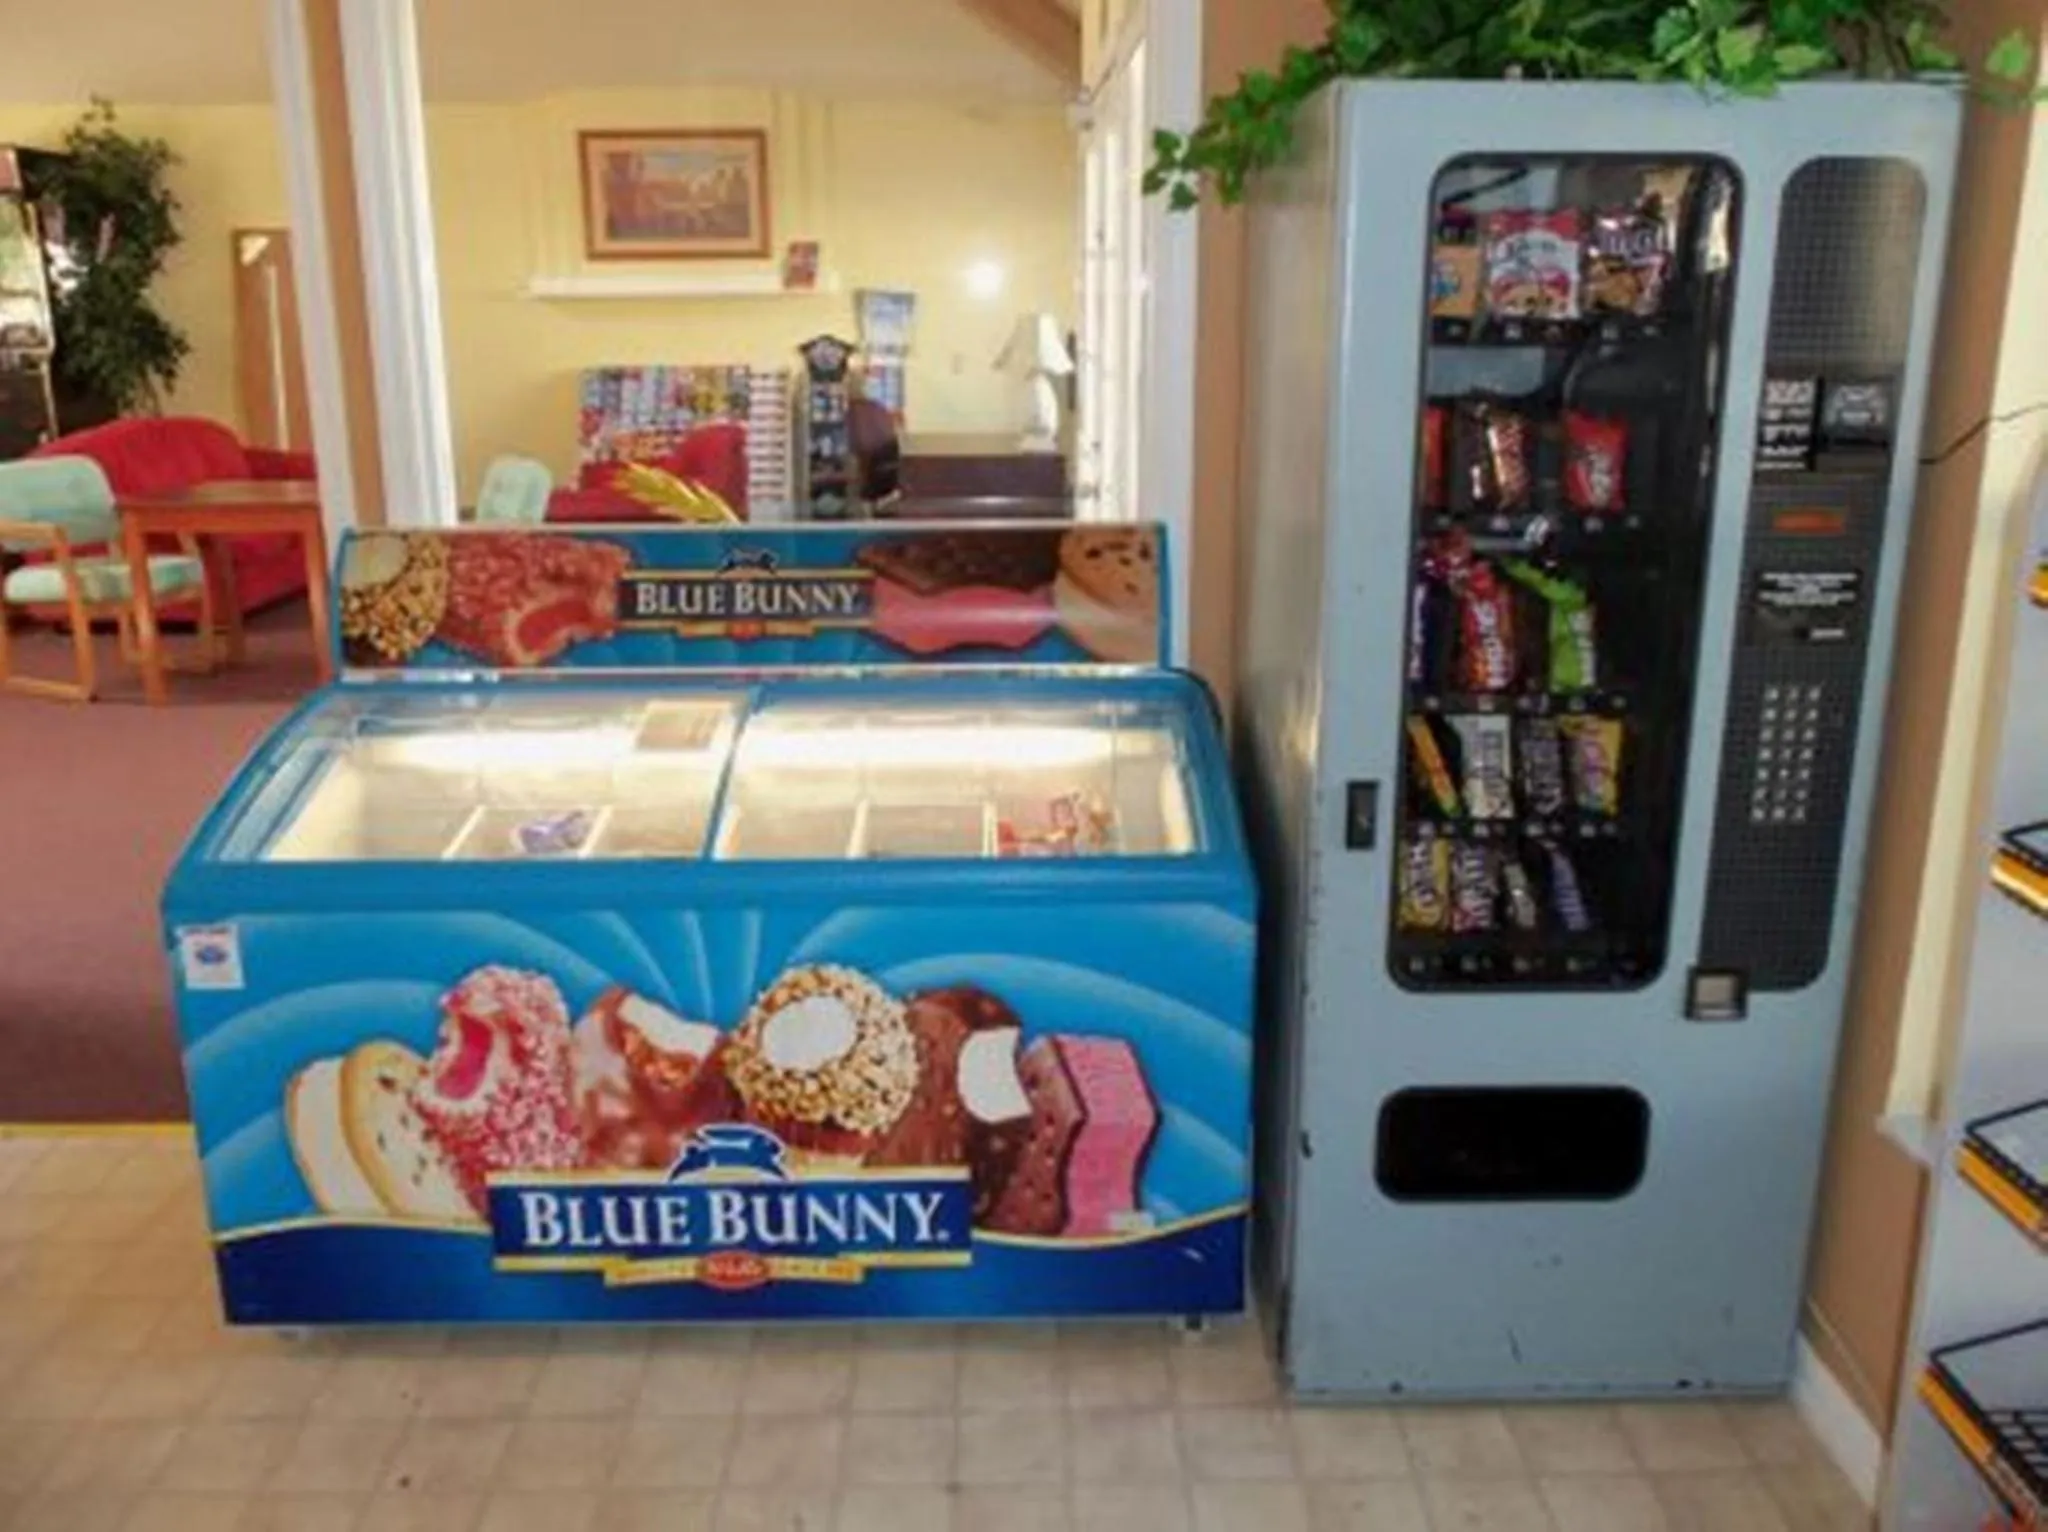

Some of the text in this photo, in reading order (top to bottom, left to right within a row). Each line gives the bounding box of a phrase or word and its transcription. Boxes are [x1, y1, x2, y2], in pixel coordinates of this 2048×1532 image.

[636, 579, 859, 615] BLUE BUNNY
[519, 1191, 692, 1246] BLUE
